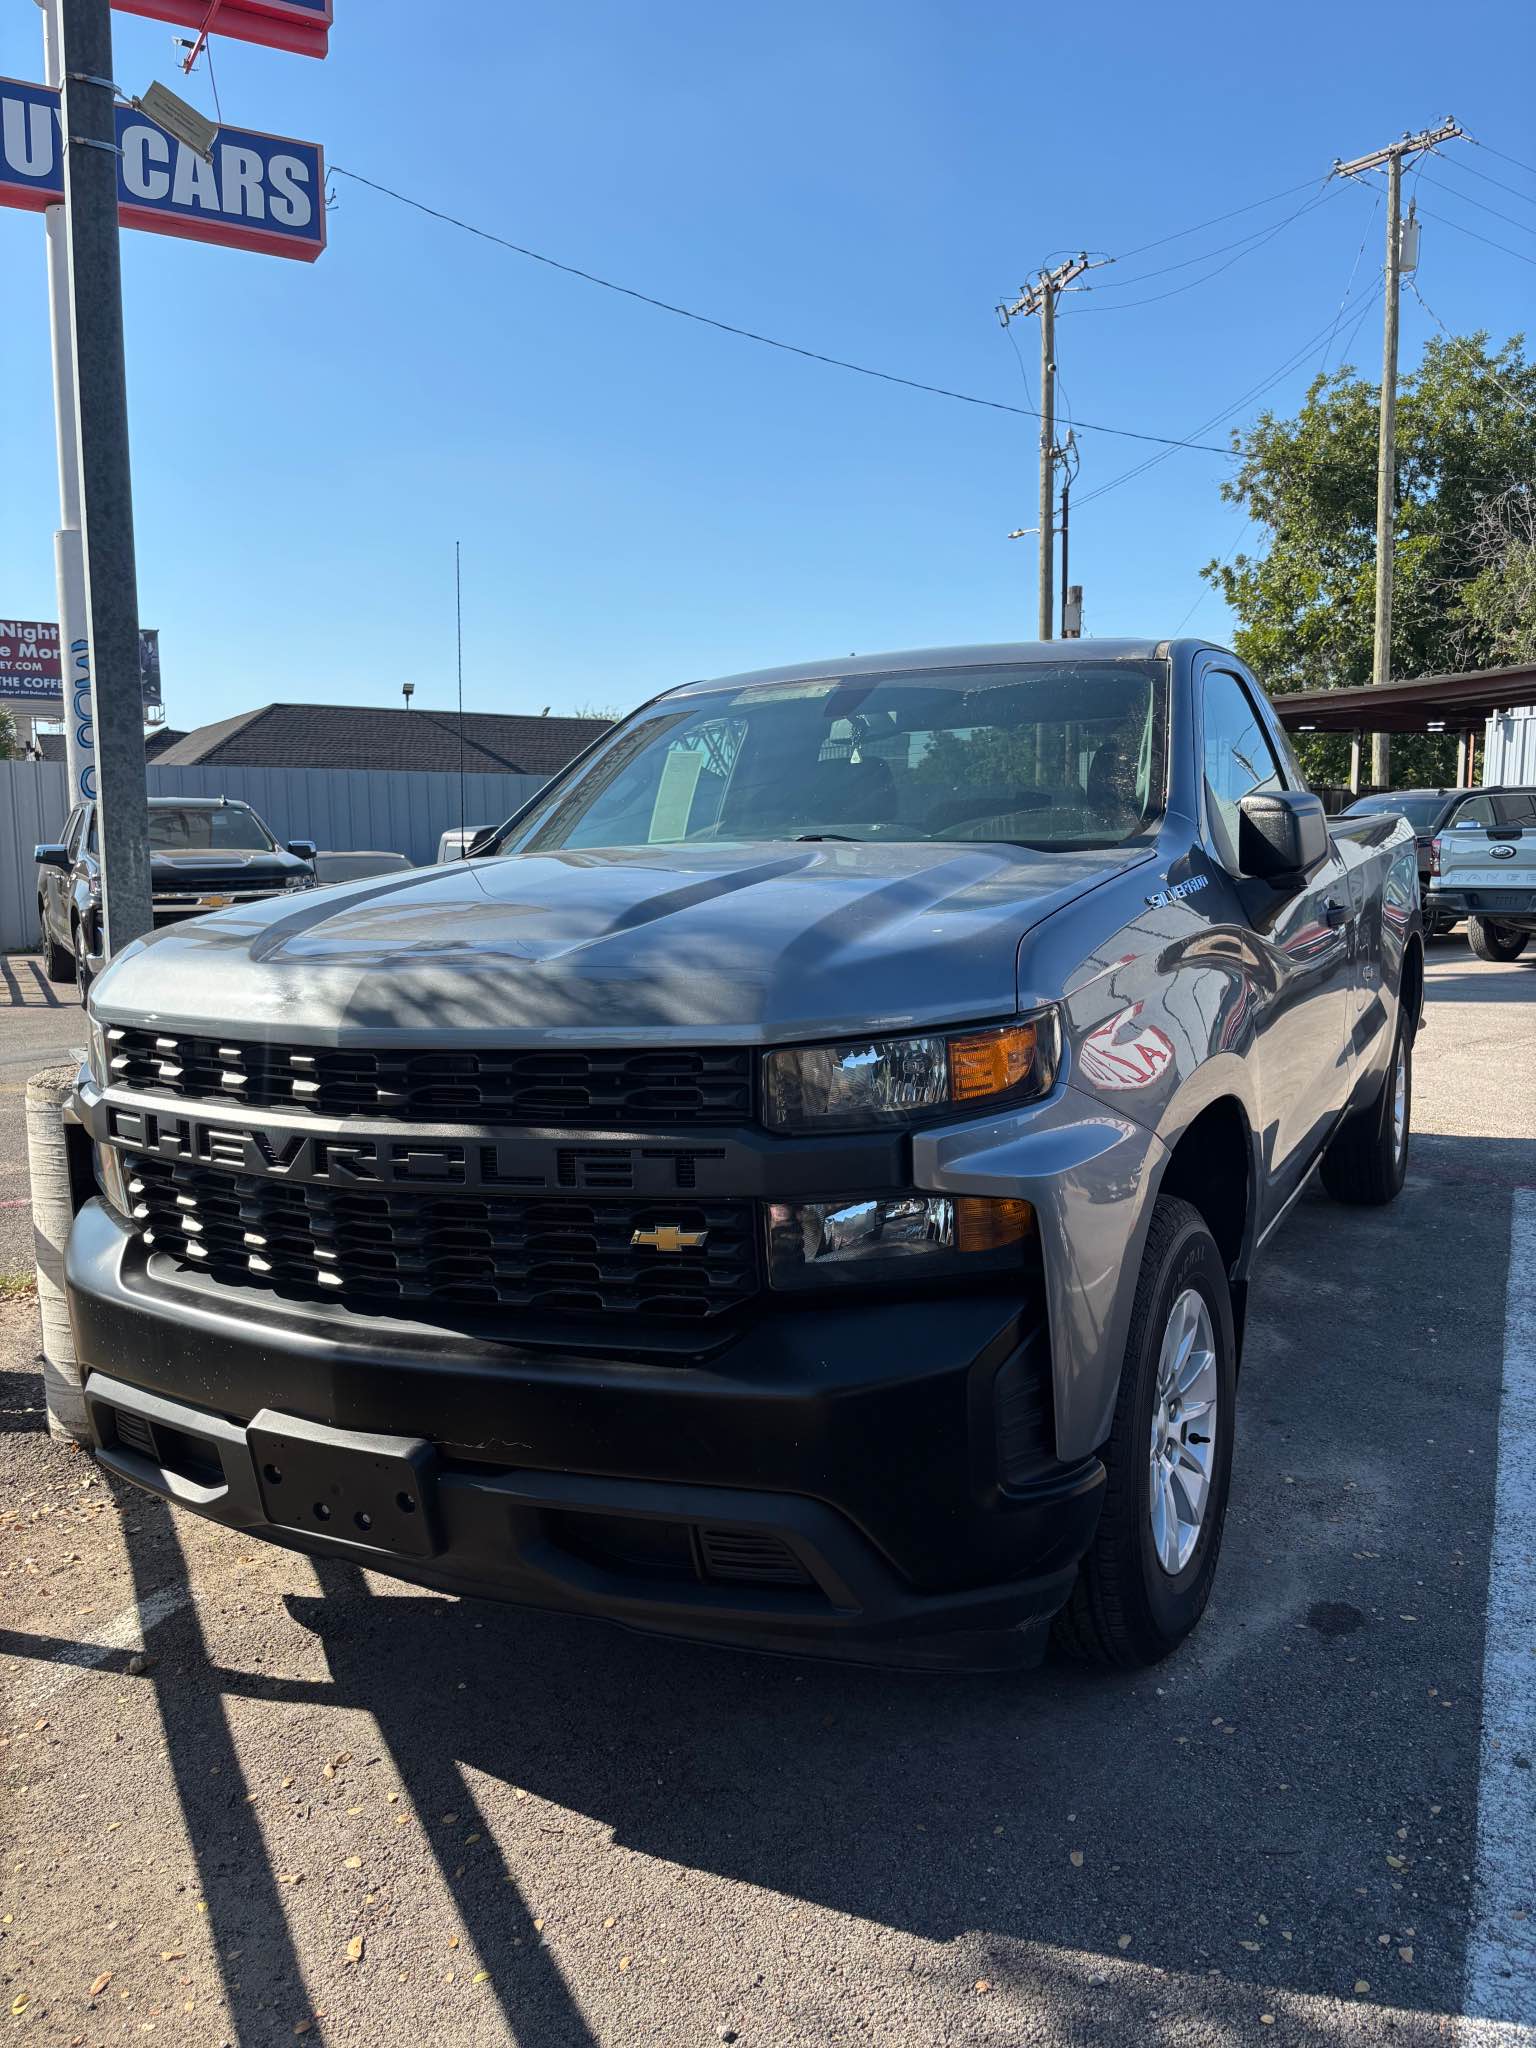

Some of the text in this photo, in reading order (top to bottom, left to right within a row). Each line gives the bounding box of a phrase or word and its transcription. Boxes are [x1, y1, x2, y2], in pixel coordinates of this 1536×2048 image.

[2, 97, 63, 178] U
[121, 125, 312, 227] CARS
[106, 1105, 727, 1190] CHEVROLET
